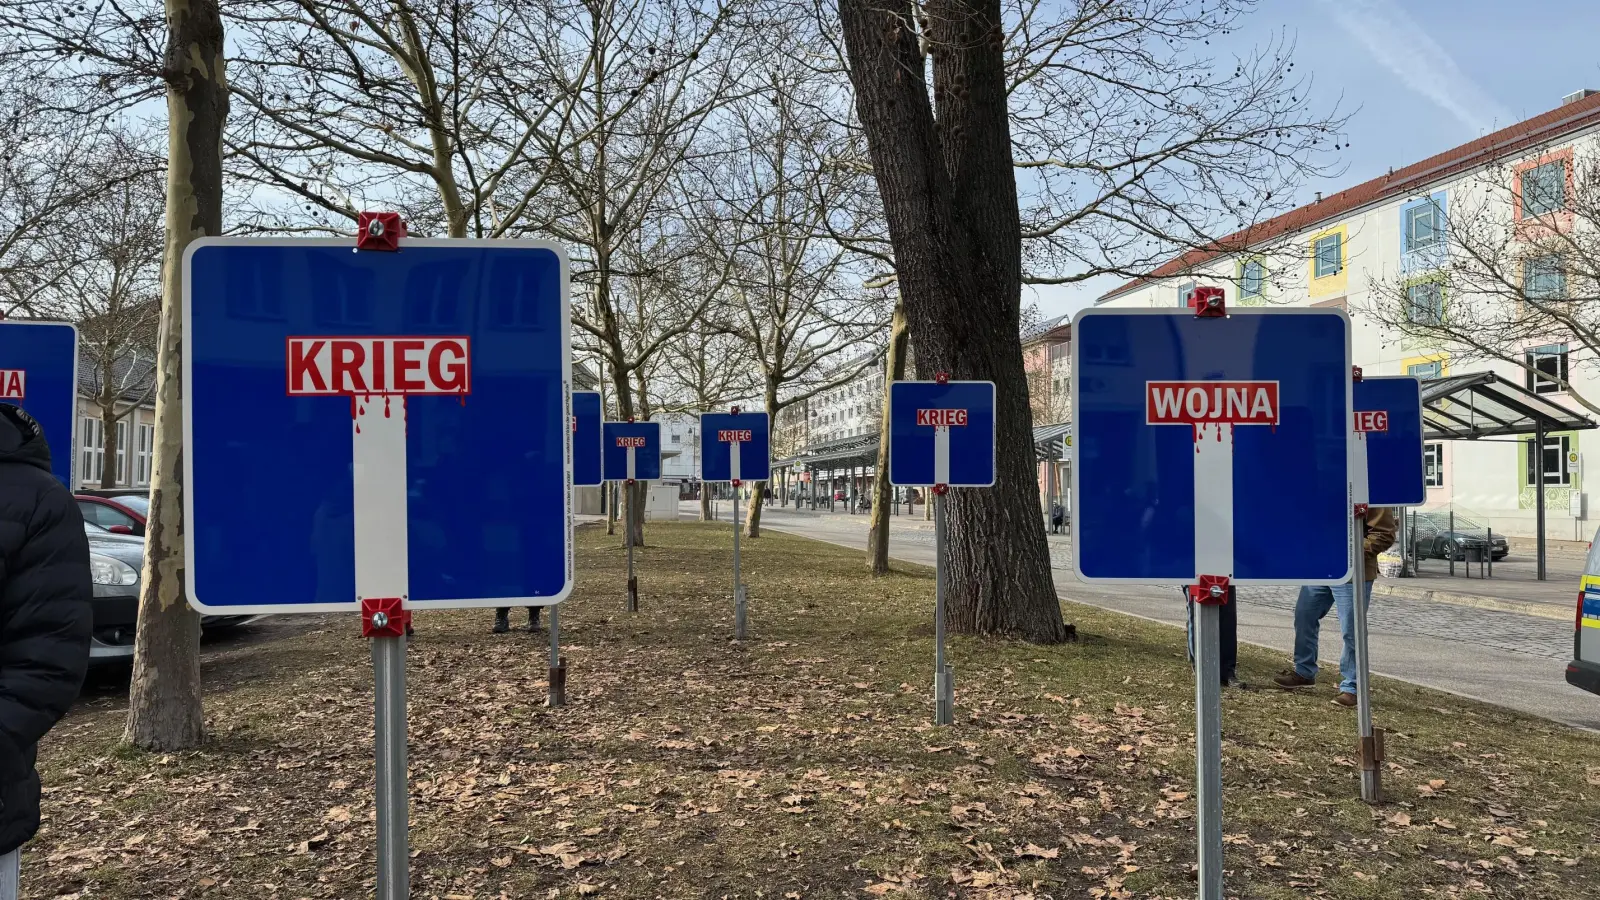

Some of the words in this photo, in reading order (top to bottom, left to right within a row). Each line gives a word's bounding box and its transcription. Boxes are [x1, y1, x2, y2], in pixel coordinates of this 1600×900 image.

[291, 340, 466, 391] KRIEG
[1151, 387, 1275, 419] WOJNA
[918, 410, 967, 425] KRIEG
[1354, 412, 1387, 430] IEG
[616, 438, 645, 447] KRIEG
[719, 431, 751, 441] KRIEG
